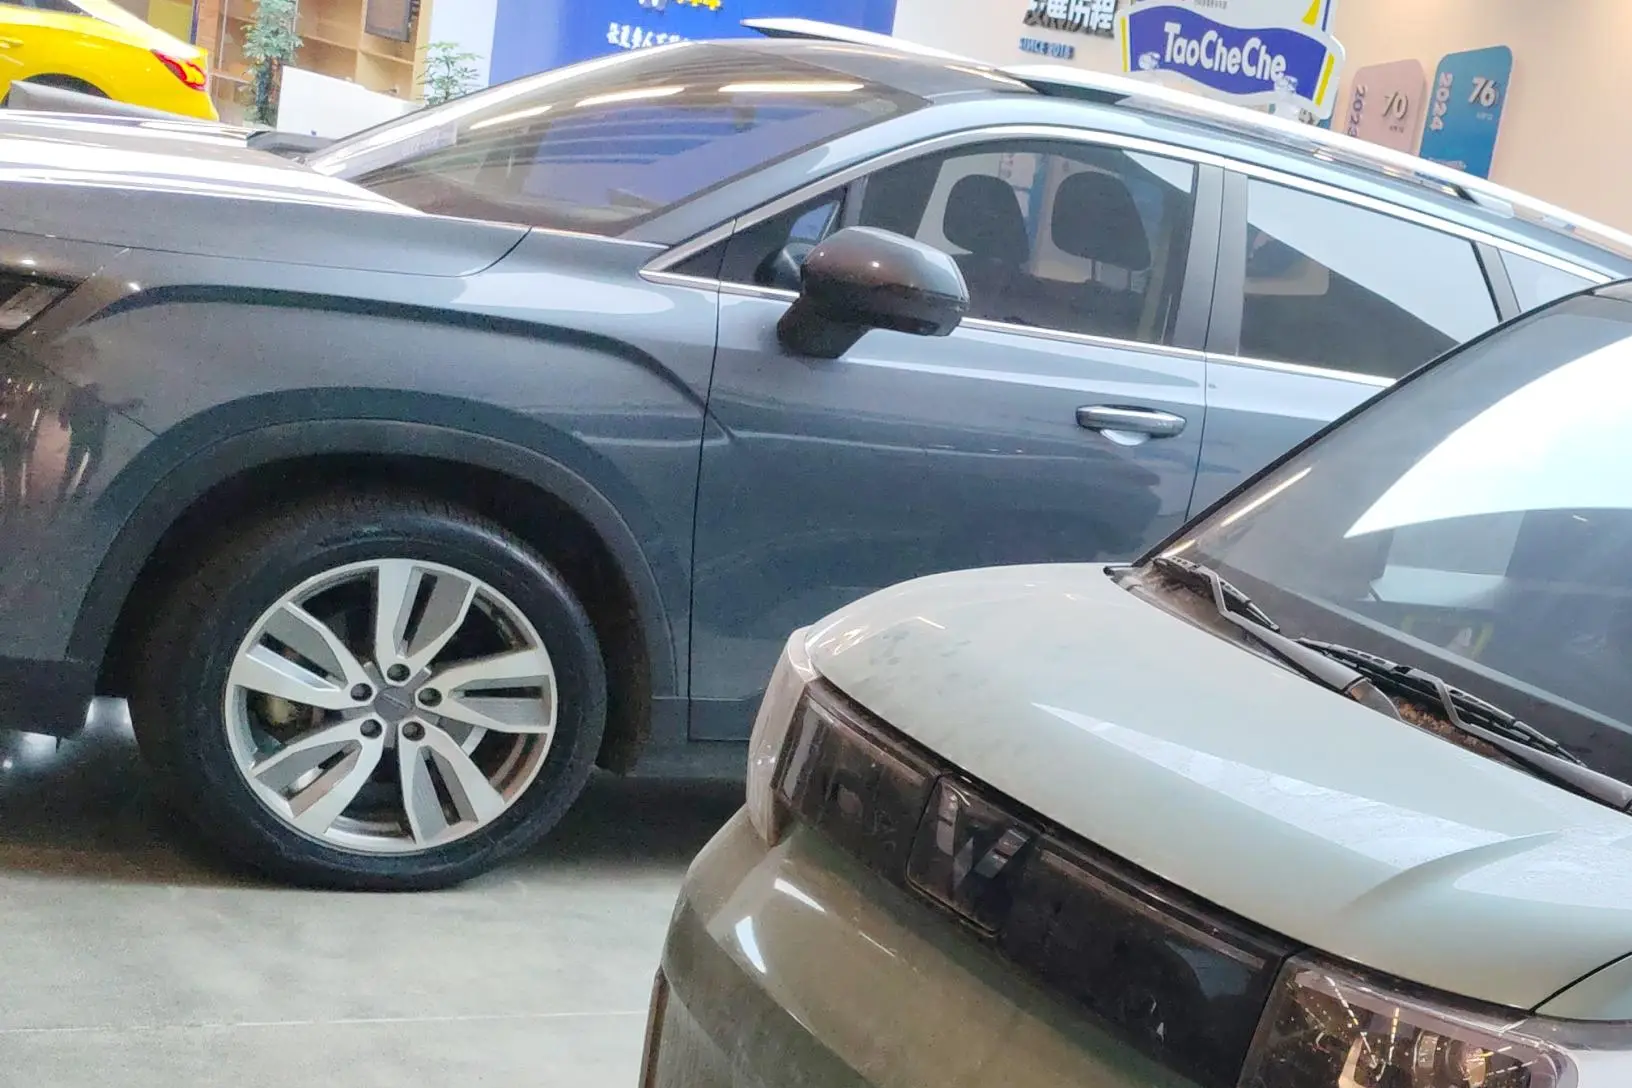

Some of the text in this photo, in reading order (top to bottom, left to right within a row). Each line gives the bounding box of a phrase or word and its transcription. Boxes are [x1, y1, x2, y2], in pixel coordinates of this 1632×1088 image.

[1163, 21, 1288, 82] TaoCheChe
[1383, 91, 1409, 121] 70
[1430, 71, 1454, 132] 2024
[1468, 76, 1501, 108] 76
